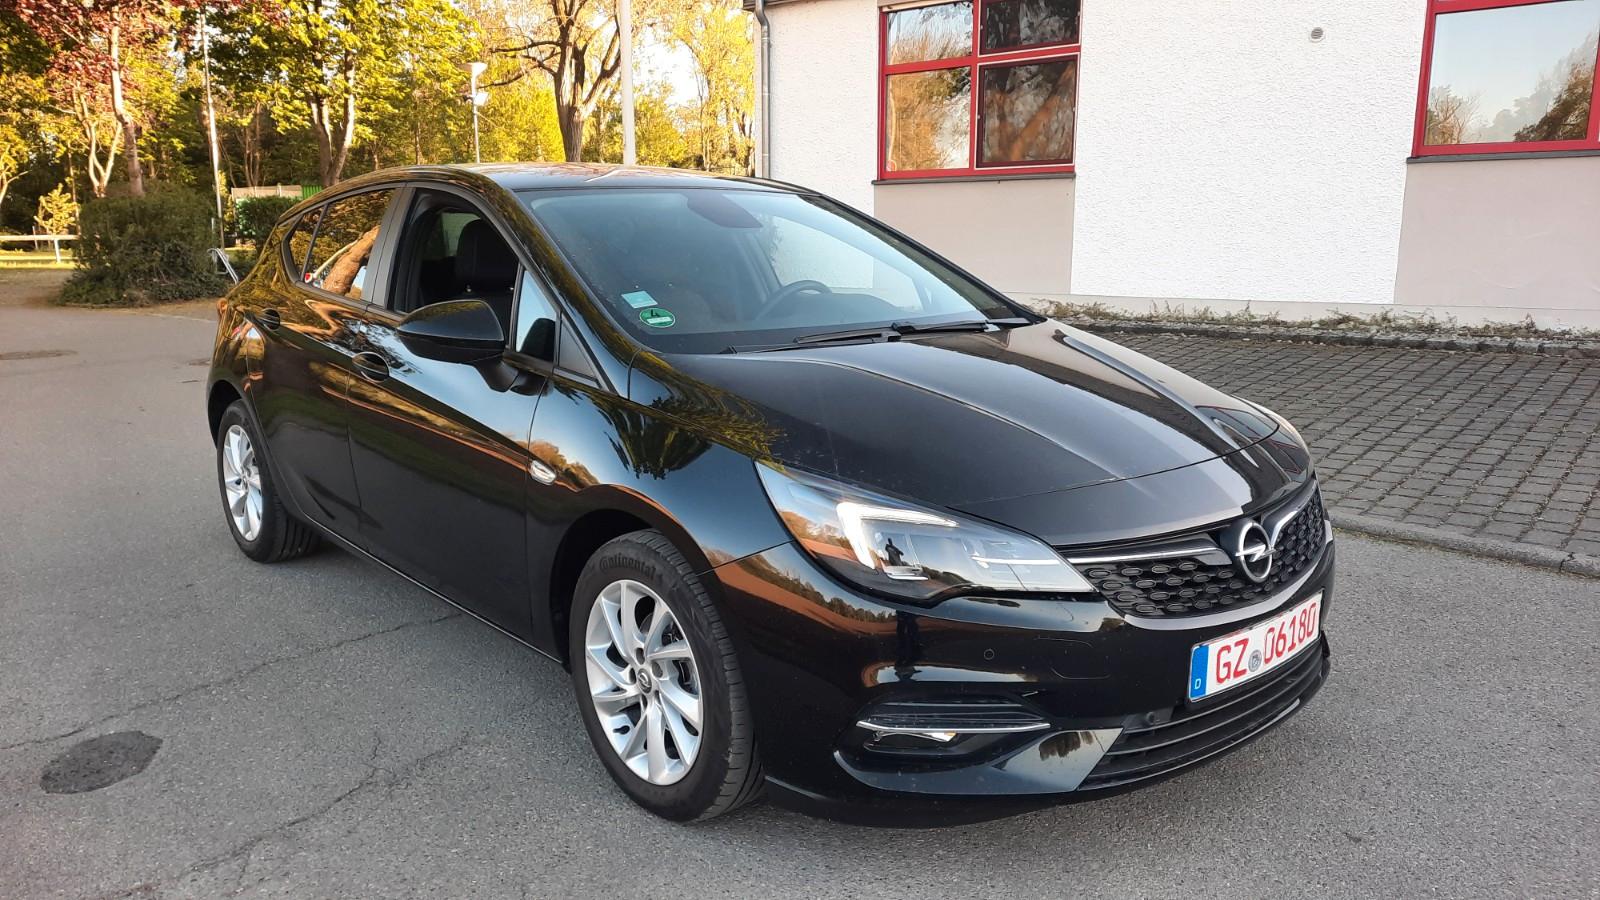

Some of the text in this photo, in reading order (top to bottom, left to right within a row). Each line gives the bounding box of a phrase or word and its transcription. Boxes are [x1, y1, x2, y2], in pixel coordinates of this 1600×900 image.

[600, 553, 657, 581] Continental
[1215, 602, 1317, 684] GZ 06180
[1194, 678, 1202, 690] D
